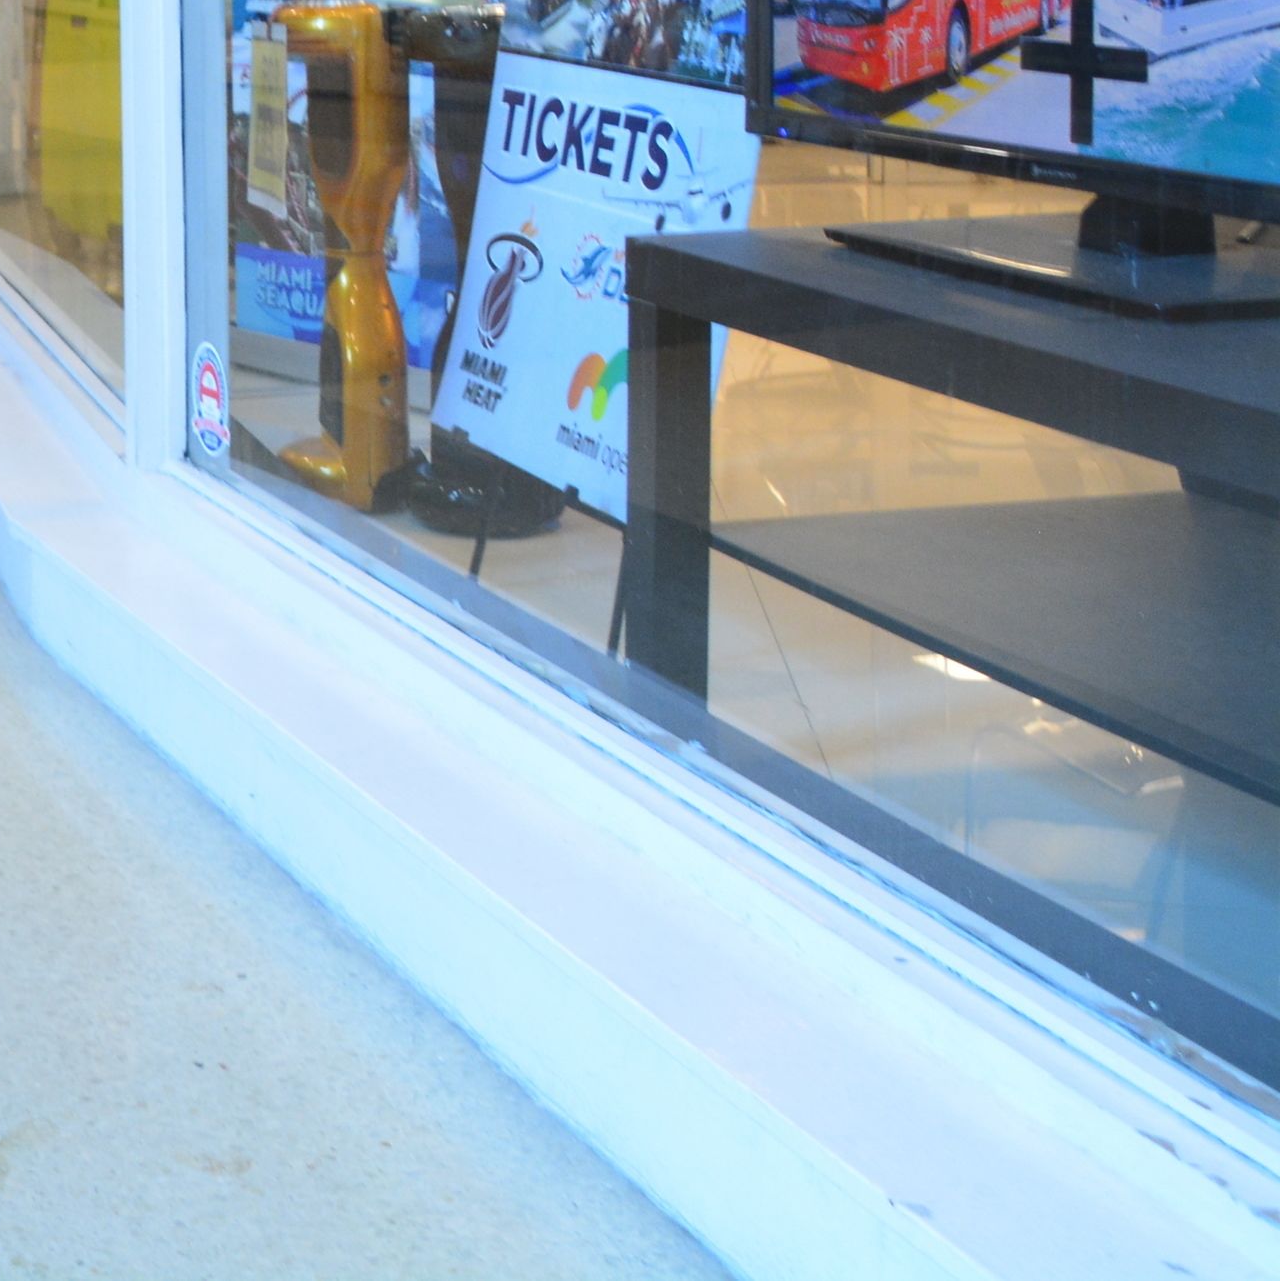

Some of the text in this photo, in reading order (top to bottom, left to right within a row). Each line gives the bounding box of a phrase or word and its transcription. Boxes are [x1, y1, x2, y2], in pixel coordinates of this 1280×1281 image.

[502, 88, 675, 191] TICKETS
[257, 261, 313, 290] MIAMI
[460, 348, 508, 387] MIAMI
[463, 378, 503, 414] HEAT
[556, 421, 602, 460] miami
